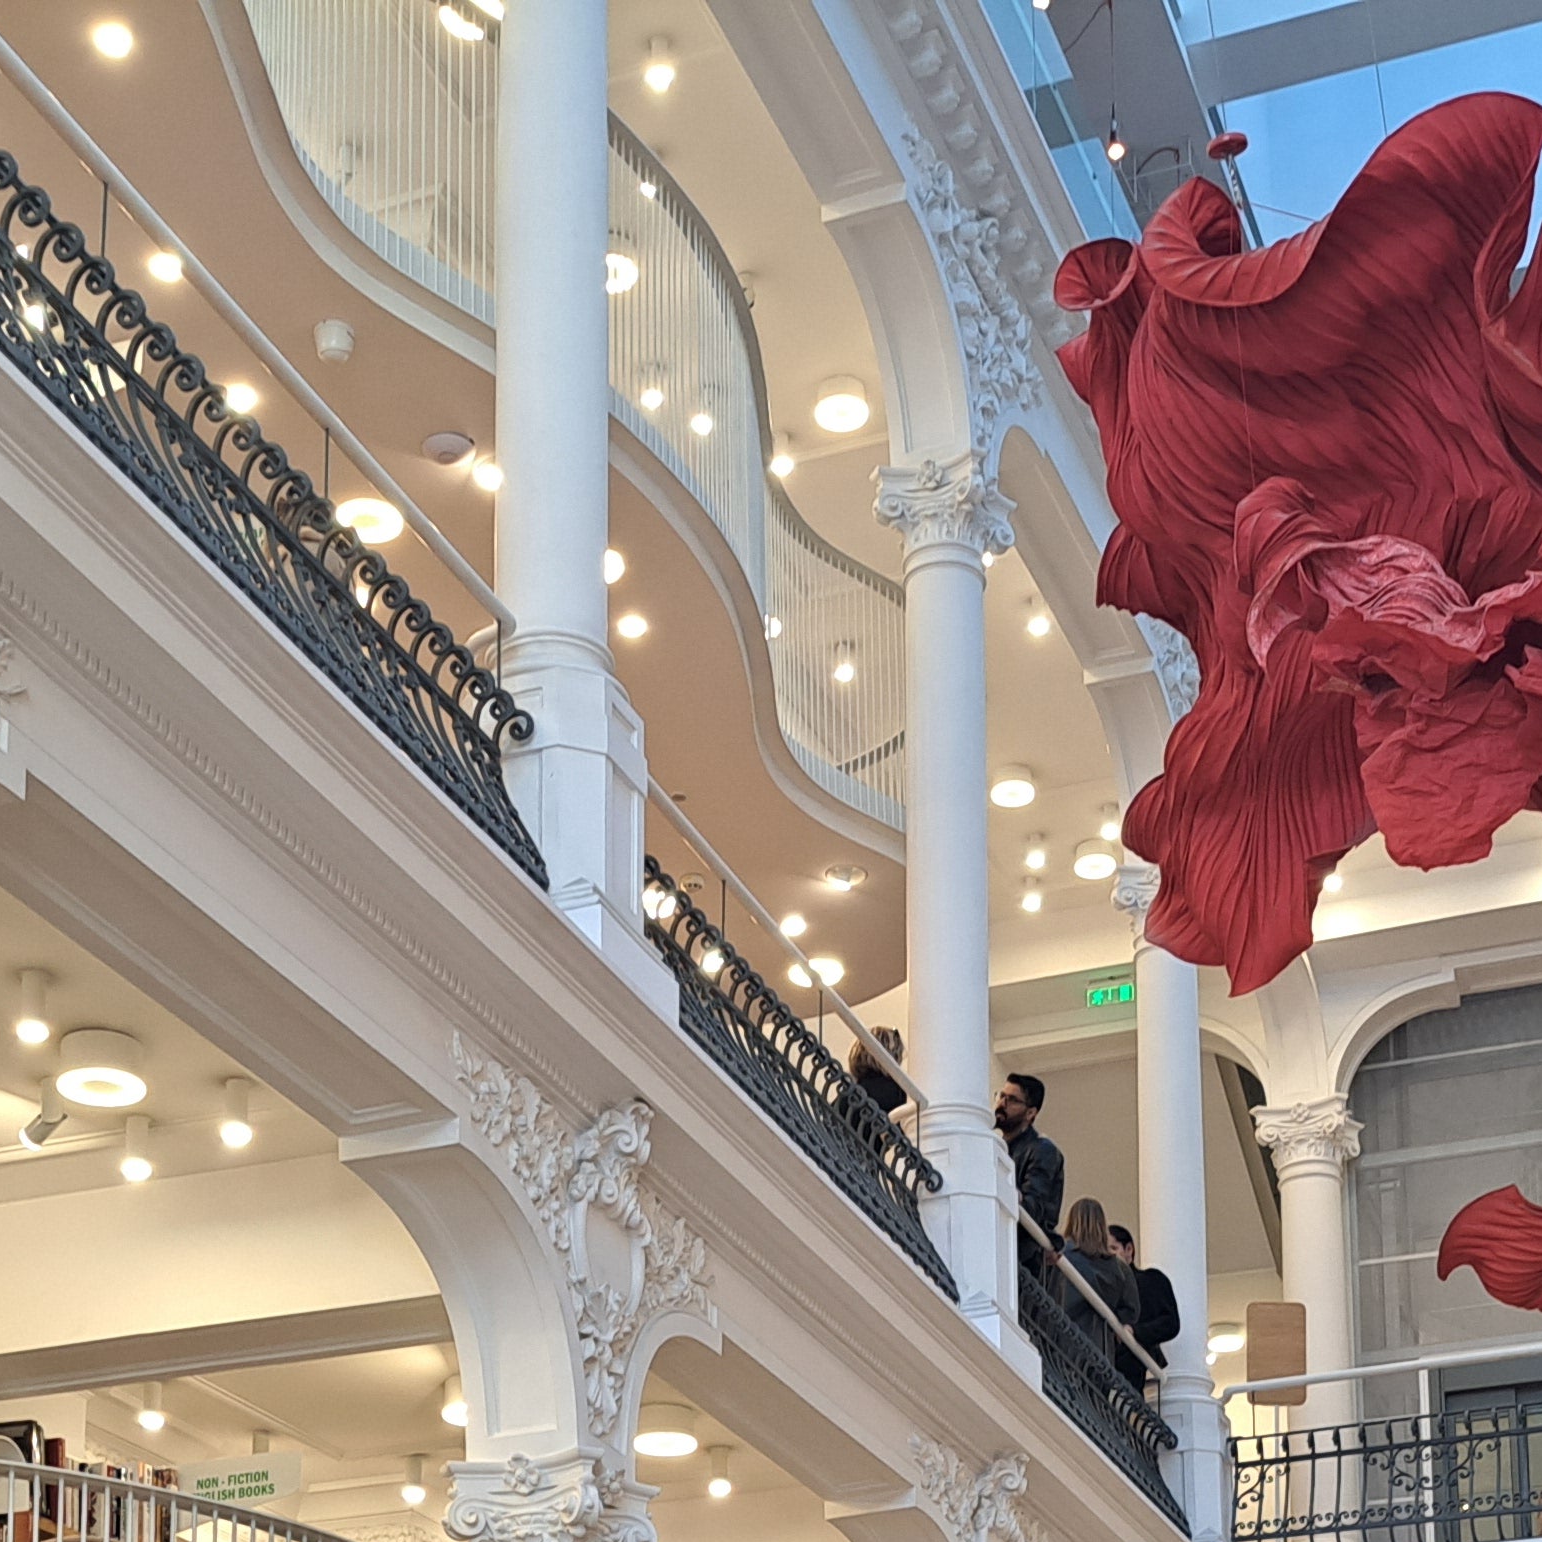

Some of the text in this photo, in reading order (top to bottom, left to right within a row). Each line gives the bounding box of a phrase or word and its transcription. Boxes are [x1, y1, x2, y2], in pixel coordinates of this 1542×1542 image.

[196, 1476, 219, 1490] NON
[227, 1470, 270, 1486] FICTION
[238, 1483, 276, 1499] BOOKS
